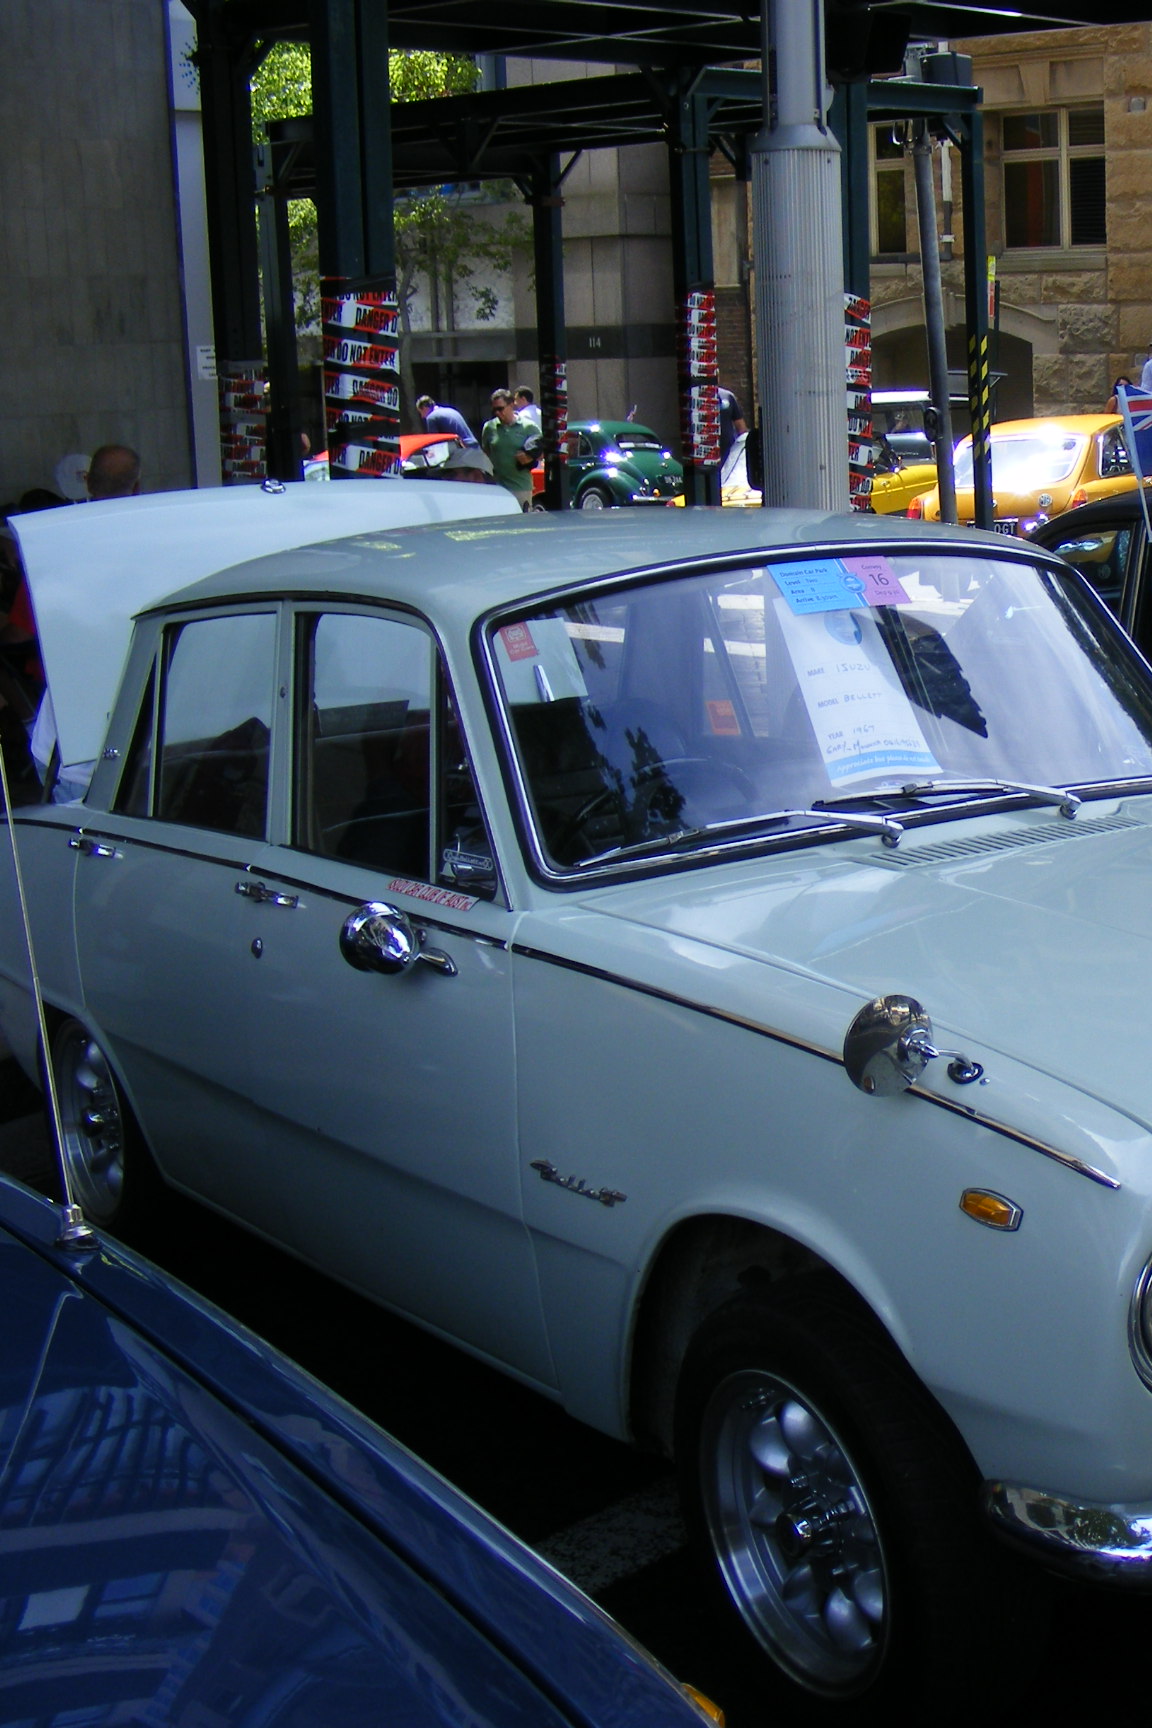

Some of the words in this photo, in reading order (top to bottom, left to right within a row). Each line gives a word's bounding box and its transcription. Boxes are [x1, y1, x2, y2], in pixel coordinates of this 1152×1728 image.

[589, 337, 601, 348] 114
[337, 342, 348, 361] DO
[350, 344, 368, 363] NOT
[868, 573, 890, 586] 16
[818, 698, 839, 708] MODEL
[828, 731, 843, 740] YEAR
